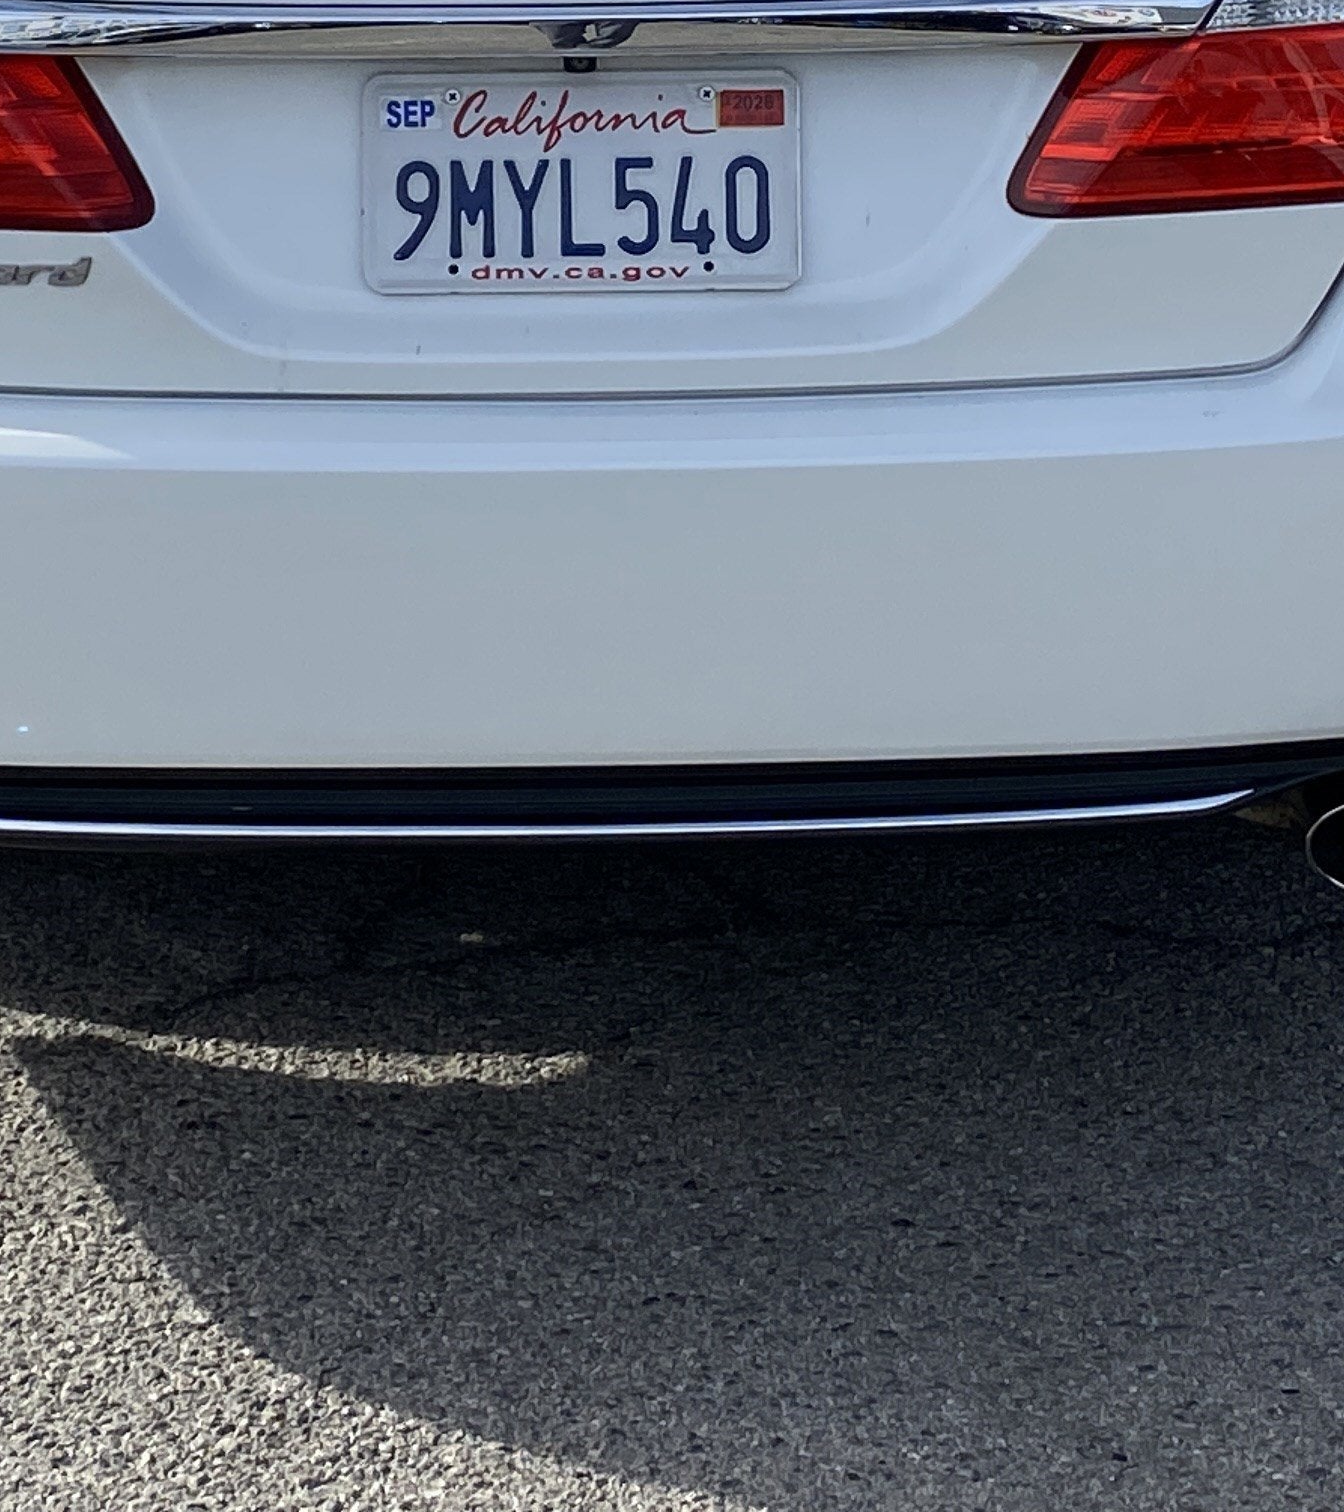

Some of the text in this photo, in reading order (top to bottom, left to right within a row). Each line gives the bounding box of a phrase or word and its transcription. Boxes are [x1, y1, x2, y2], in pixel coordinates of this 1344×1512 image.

[386, 100, 436, 128] SEP
[453, 89, 717, 152] California
[393, 155, 771, 261] 9MYL540
[470, 263, 691, 281] dmv.ca.gov
